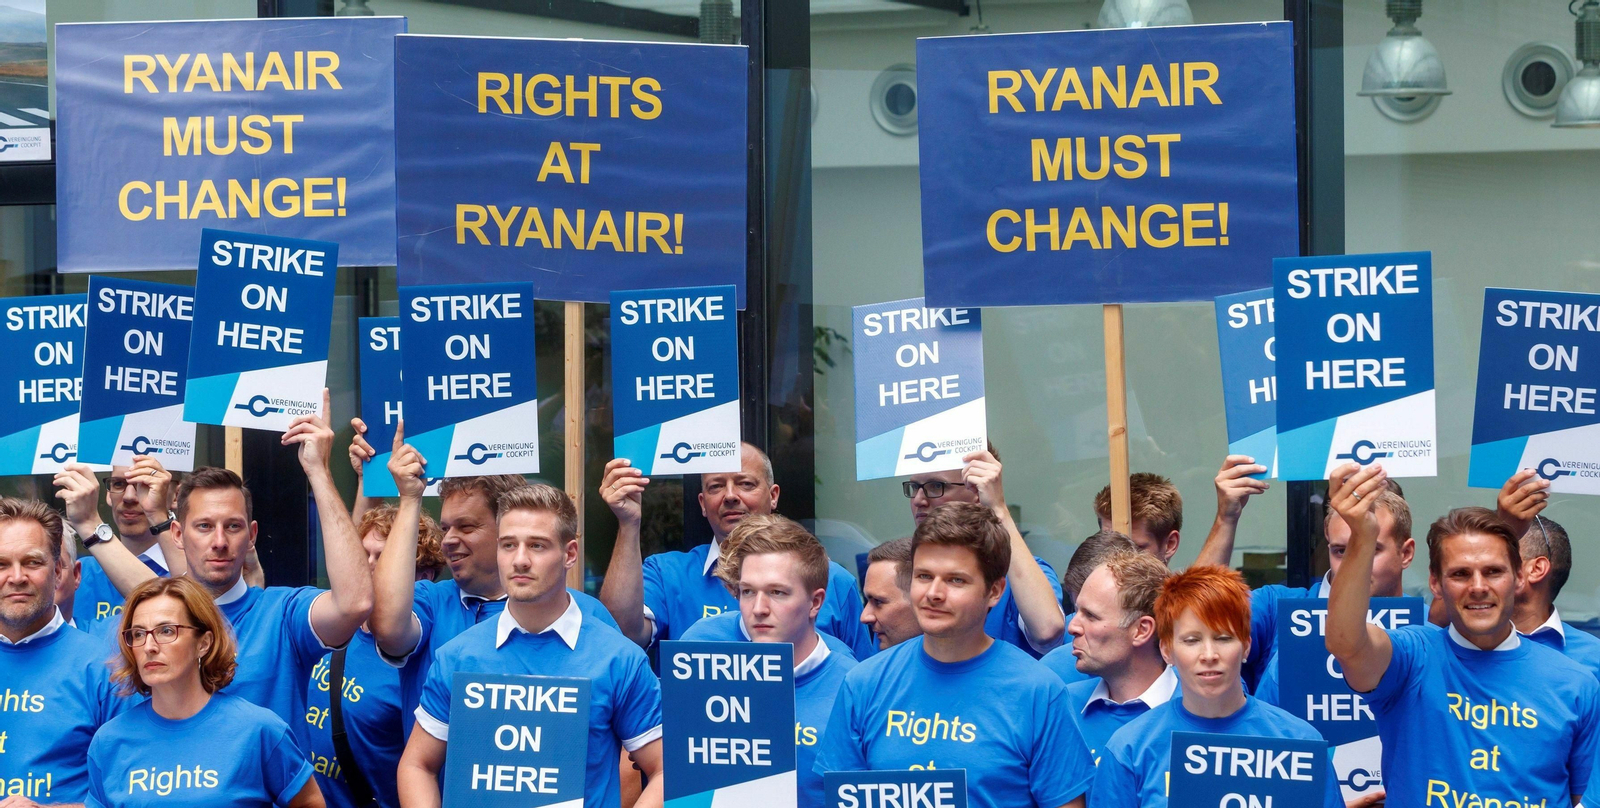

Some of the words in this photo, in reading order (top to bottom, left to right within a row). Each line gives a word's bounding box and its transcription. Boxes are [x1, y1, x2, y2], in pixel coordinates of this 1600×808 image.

[124, 51, 343, 93] RYANAIR
[478, 72, 662, 119] RIGHTS
[987, 62, 1223, 113] RYANAIR
[163, 115, 304, 156] MUST
[536, 142, 601, 184] AT
[1031, 133, 1181, 182] MUST
[118, 178, 346, 221] CHANGE!
[456, 204, 683, 254] RYANAIR!
[986, 202, 1229, 253] CHANGE!
[211, 240, 325, 277] STRIKE
[1287, 264, 1419, 299] STRIKE
[98, 287, 194, 321] STRIKE
[241, 283, 288, 312] ON
[411, 293, 522, 322] STRIKE
[620, 296, 724, 325] STRIKE
[6, 304, 88, 331] STRIK
[863, 307, 970, 337] STRIKE
[1326, 312, 1381, 343] ON
[124, 329, 163, 356] ON
[217, 320, 304, 354] HERE
[445, 334, 490, 360] ON
[652, 336, 694, 361] ON
[34, 341, 73, 366] ON
[895, 341, 939, 368] ON
[1528, 343, 1579, 372] ON
[104, 365, 178, 396] HERE
[427, 372, 512, 400] HERE
[635, 373, 715, 400] HERE
[1306, 357, 1406, 390] HERE
[270, 398, 317, 409] VEREINIGUNG
[879, 374, 960, 407] HERE
[1503, 383, 1597, 415] HERE
[151, 439, 191, 449] VEREINIGUNG
[165, 447, 190, 456] COCKPIT
[488, 442, 535, 451] VEREINIGUNG
[505, 449, 535, 458] COCKPIT
[692, 441, 736, 451] VEREINIGUNG
[709, 448, 736, 457] COCKPIT
[938, 436, 983, 449] VEREINIGUNG
[955, 445, 983, 454] COCKPIT
[1377, 440, 1431, 449] VEREINIGUNG
[1398, 449, 1431, 458] COCKPIT
[1290, 608, 1411, 637] STKE
[311, 657, 364, 702] Rigts
[672, 652, 782, 682] STRIKE
[0, 688, 45, 713] hts
[464, 682, 579, 714] STRIKE
[705, 695, 750, 724] ON
[1307, 694, 1375, 721] HER
[1447, 693, 1538, 730] Rights
[306, 705, 329, 729] at
[886, 710, 977, 745] Rights
[494, 724, 541, 753] ON
[688, 737, 772, 766] HERE
[1184, 745, 1314, 782] STRIKE
[1470, 745, 1501, 771] at
[128, 764, 219, 797] Rights
[471, 764, 560, 795] HERE
[837, 782, 955, 808] STRIKE
